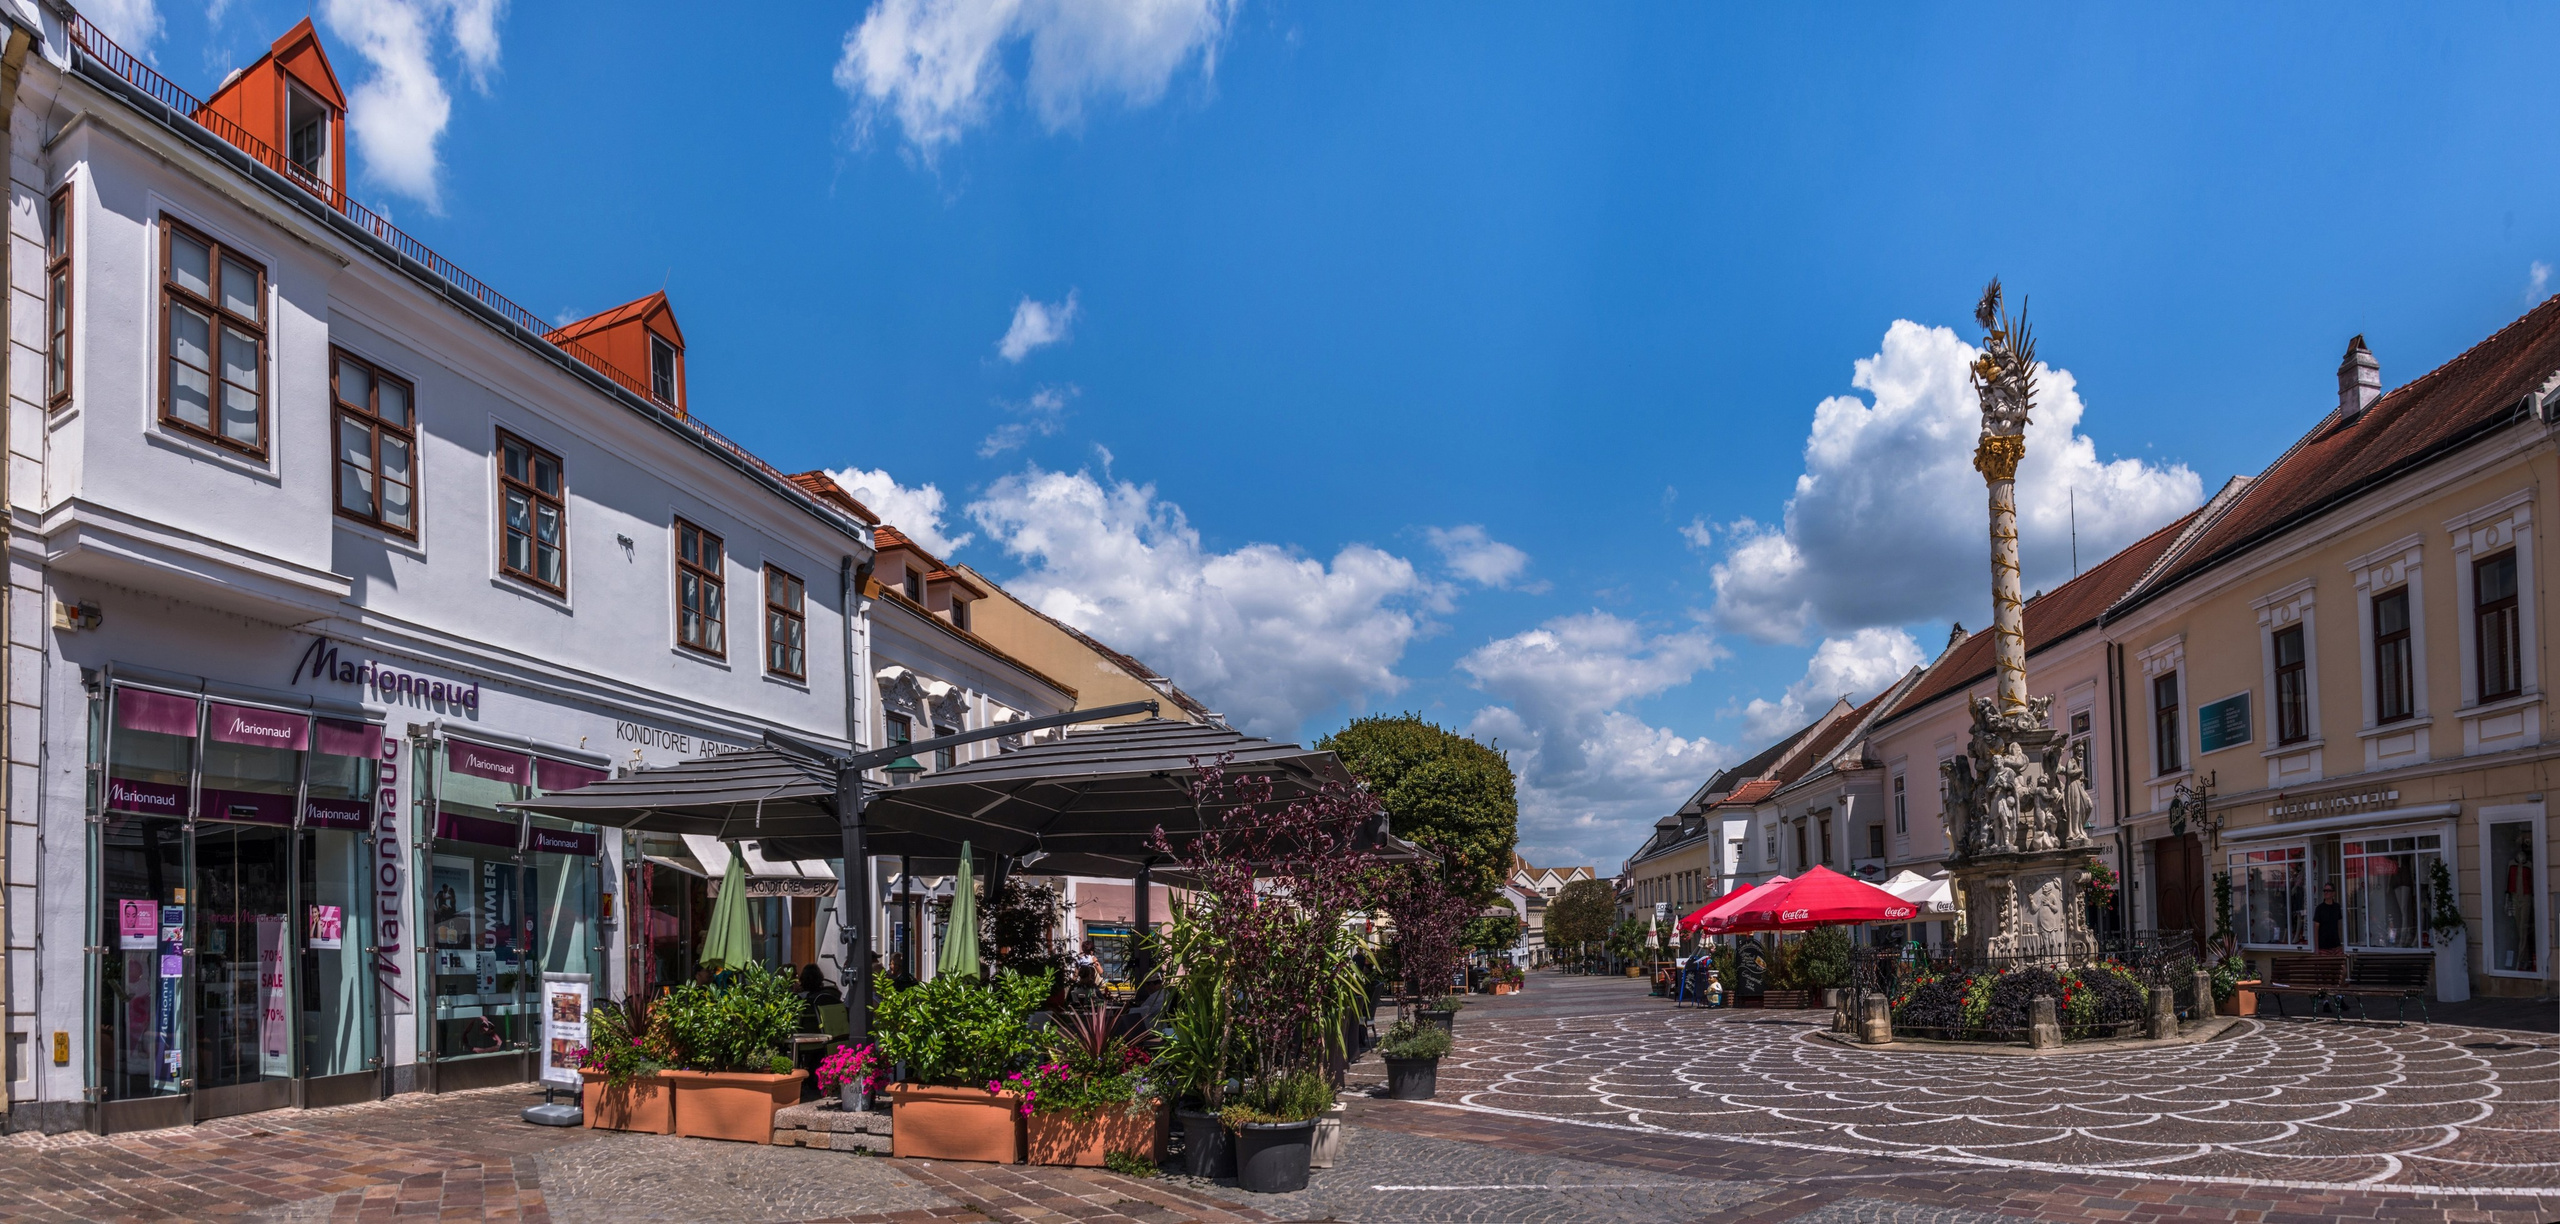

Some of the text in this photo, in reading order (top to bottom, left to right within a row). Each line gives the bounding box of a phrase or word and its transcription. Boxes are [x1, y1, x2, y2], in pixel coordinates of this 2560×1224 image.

[291, 637, 479, 708] Marionnaud
[228, 717, 291, 738] Marionnaud
[616, 720, 743, 758] KONDITOREI ARN
[465, 753, 514, 774] Marionnaud
[108, 783, 175, 806] Marionnaud
[303, 803, 360, 821] Marionnaud
[2273, 787, 2394, 821] LIEBLINGSTEIL
[534, 832, 578, 849] Marionnaud
[372, 737, 410, 1002] Marionnaud
[752, 881, 826, 893] KONDITOREI EIS
[484, 863, 496, 949] UMMER
[1782, 908, 1809, 921] Coca-Cola
[1884, 906, 1910, 918] Coca-Cola
[320, 920, 339, 929] -70%
[261, 950, 283, 961] -70%
[261, 974, 283, 987] SALE
[261, 988, 284, 998] FEELING
[160, 977, 170, 1048] Marionn
[263, 1009, 284, 1021] -70%
